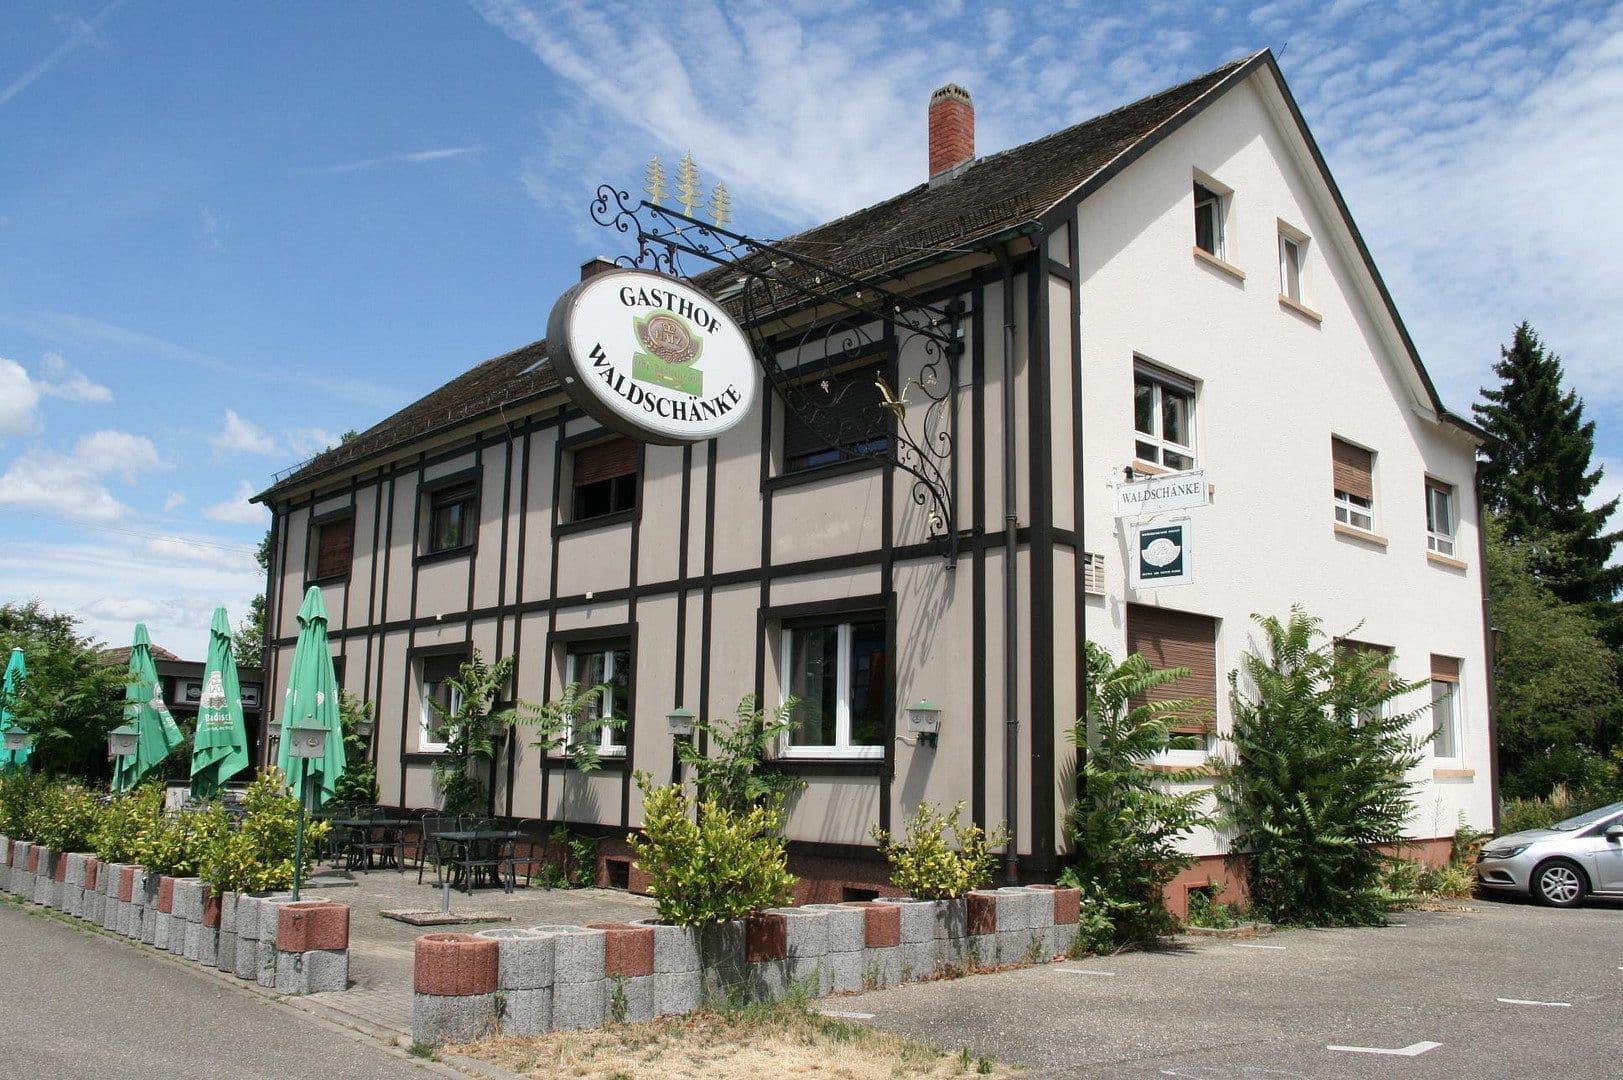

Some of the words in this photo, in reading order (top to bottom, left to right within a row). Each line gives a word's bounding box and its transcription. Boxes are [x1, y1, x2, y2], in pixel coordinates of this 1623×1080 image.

[619, 286, 722, 335] GASTHOF
[588, 342, 742, 422] WALDSCHÄNKE
[1122, 482, 1200, 503] WALDSCHÄNKE
